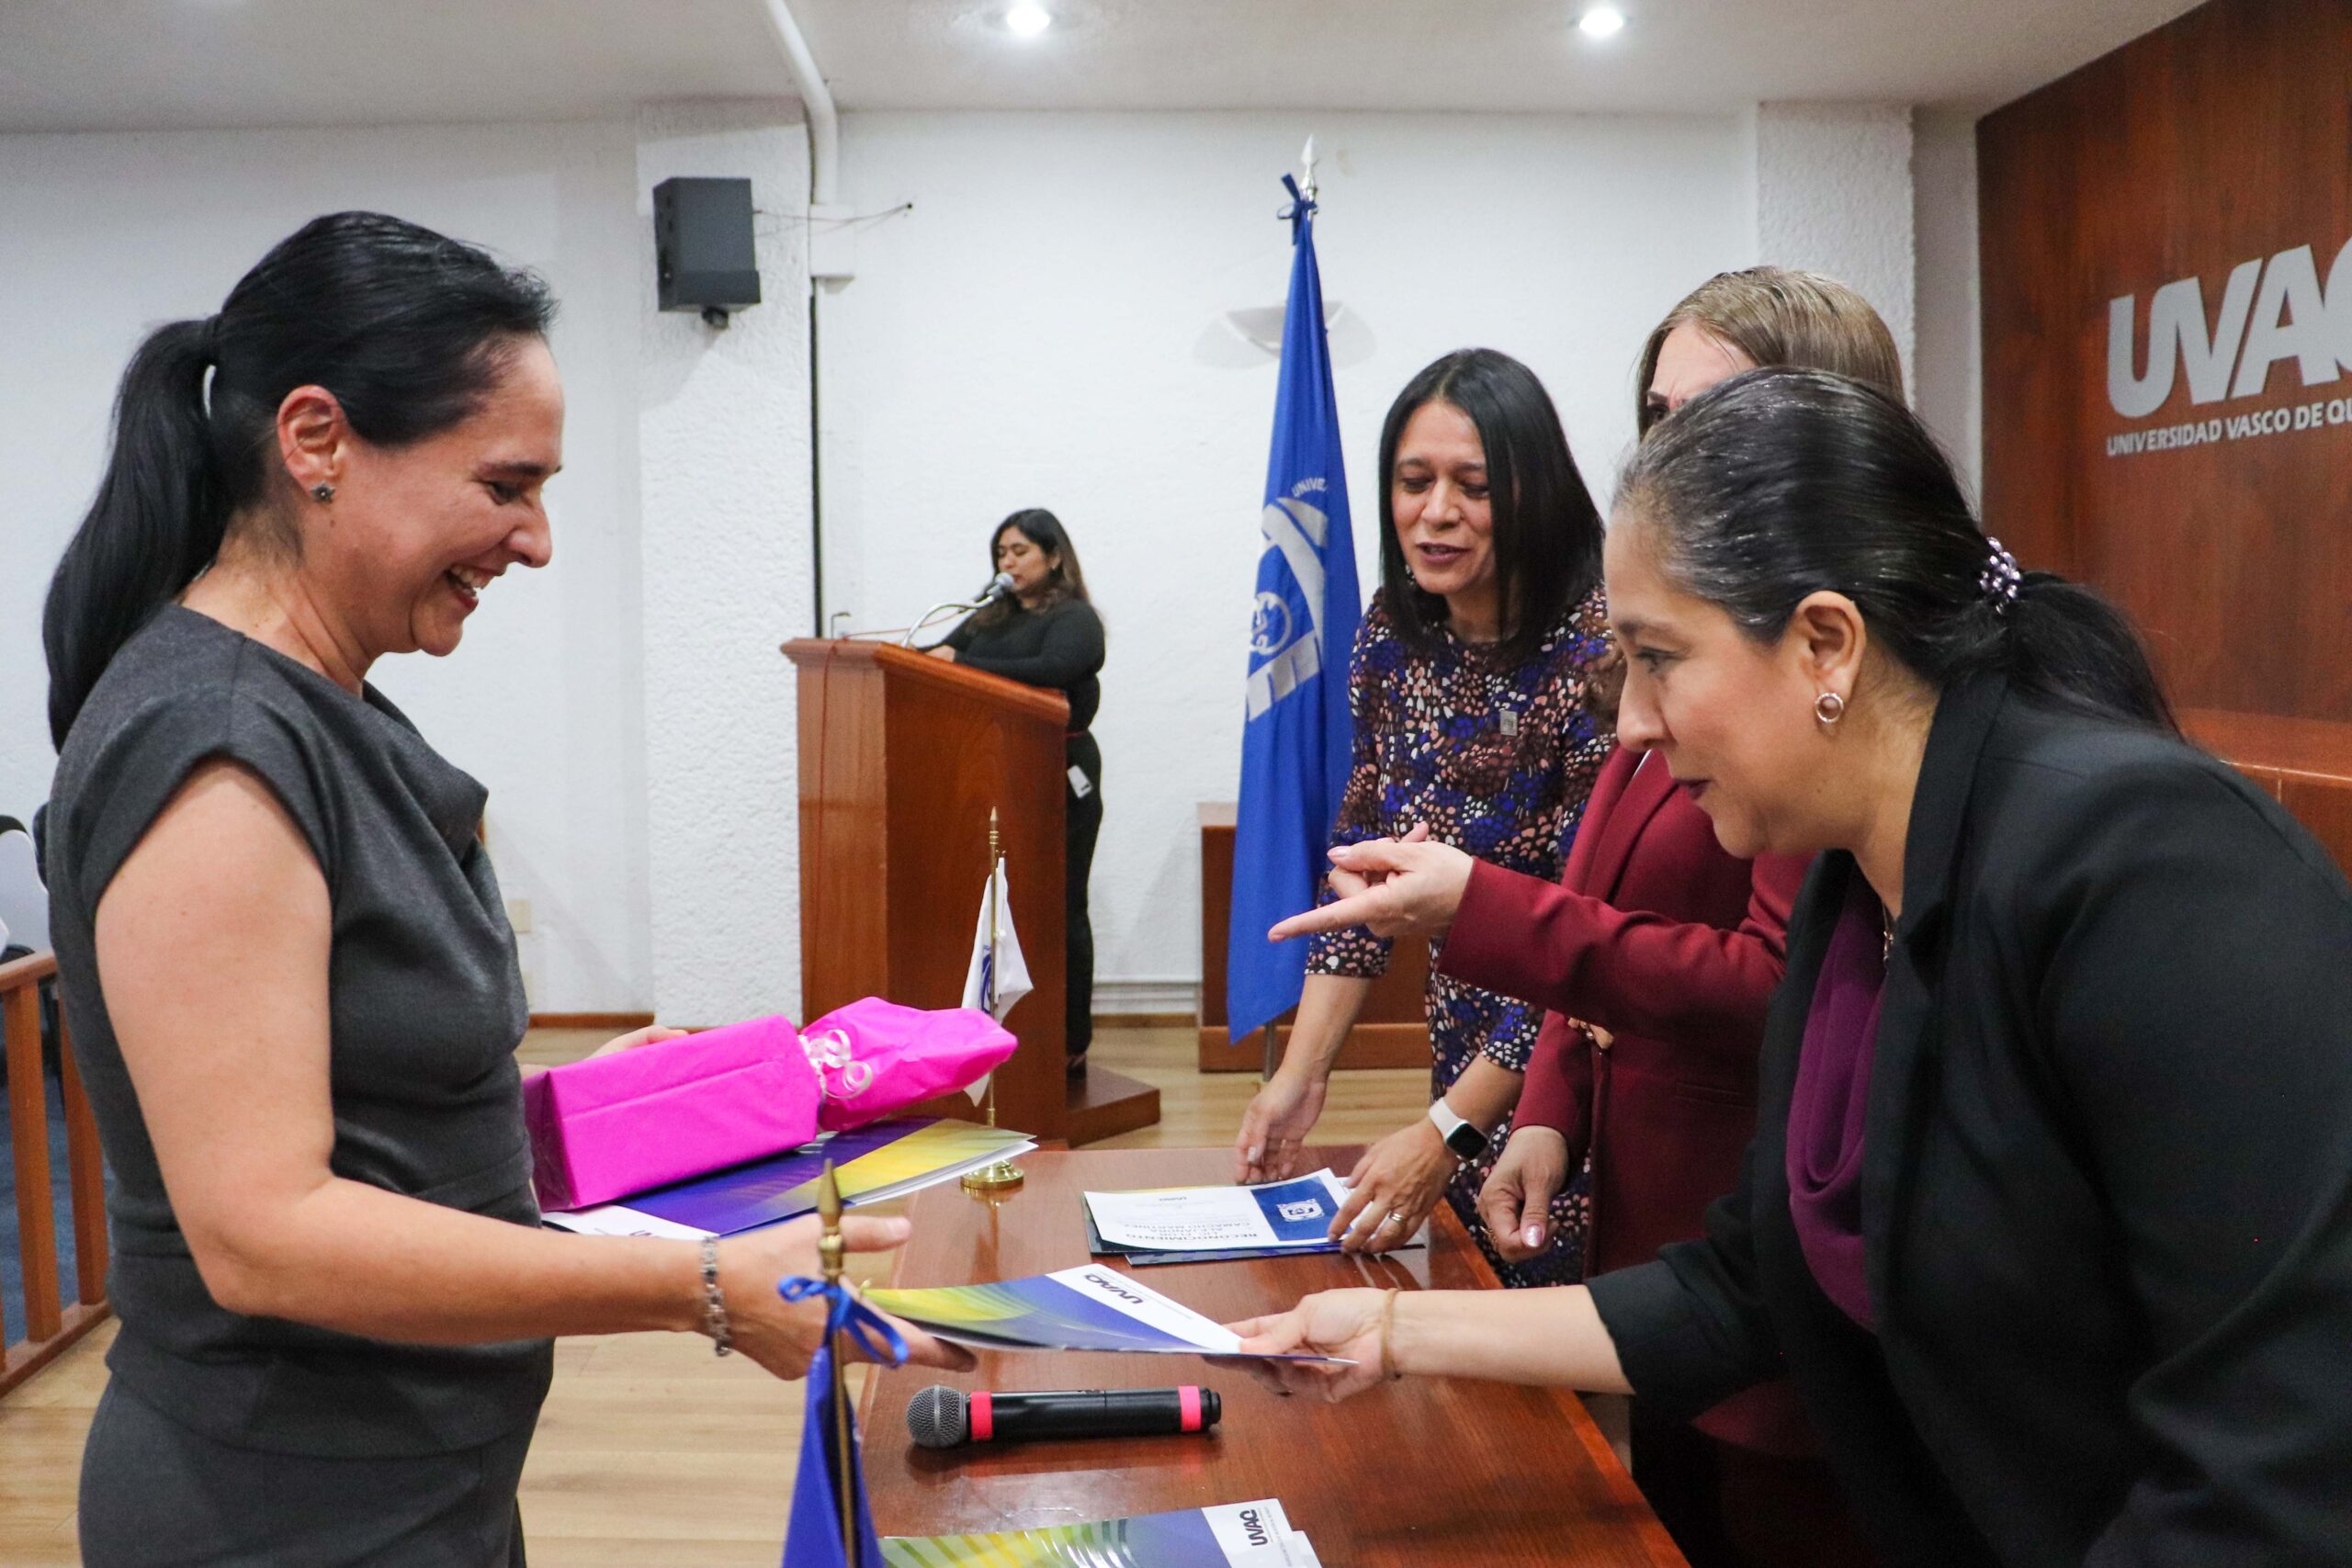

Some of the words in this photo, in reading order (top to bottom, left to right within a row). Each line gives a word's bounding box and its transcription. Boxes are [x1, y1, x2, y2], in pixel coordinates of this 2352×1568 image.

[2107, 419, 2222, 457] UNIVERSIDAD
[2226, 408, 2291, 439] VASCO
[2294, 401, 2324, 430] DE
[1291, 477, 1329, 497] UNIVE
[1084, 1273, 1144, 1304] UVAQ
[1238, 1509, 1268, 1546] UVAQ
